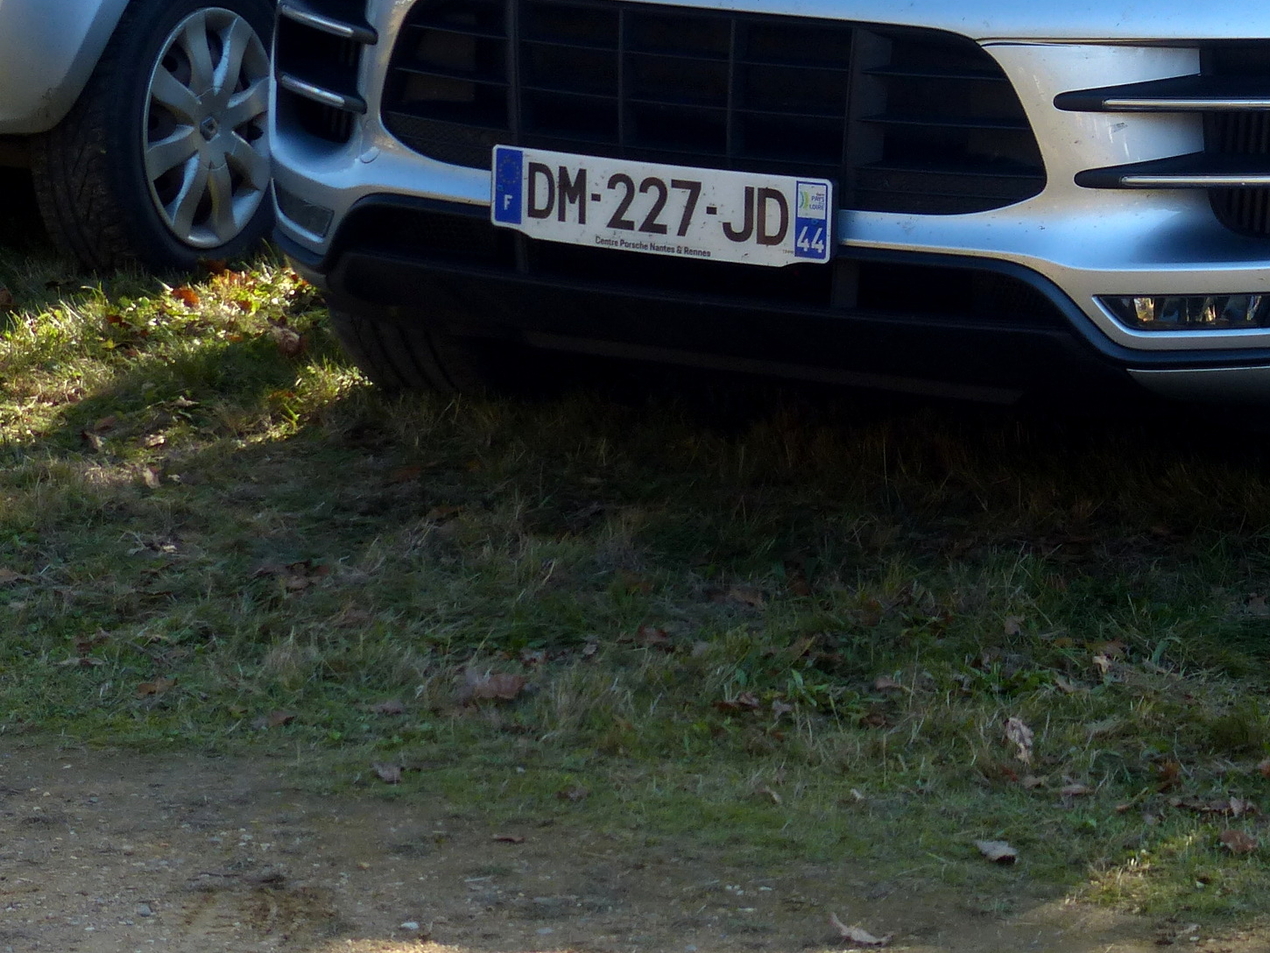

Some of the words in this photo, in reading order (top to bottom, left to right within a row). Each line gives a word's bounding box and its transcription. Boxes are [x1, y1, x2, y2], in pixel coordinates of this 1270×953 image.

[503, 194, 513, 211] F
[526, 161, 789, 246] DM-227-JD
[595, 235, 618, 247] Centre
[620, 239, 648, 251] Porsche
[650, 242, 675, 254] Nantes
[676, 246, 682, 254] &
[684, 246, 711, 257] Rennes
[797, 226, 825, 254] 44
